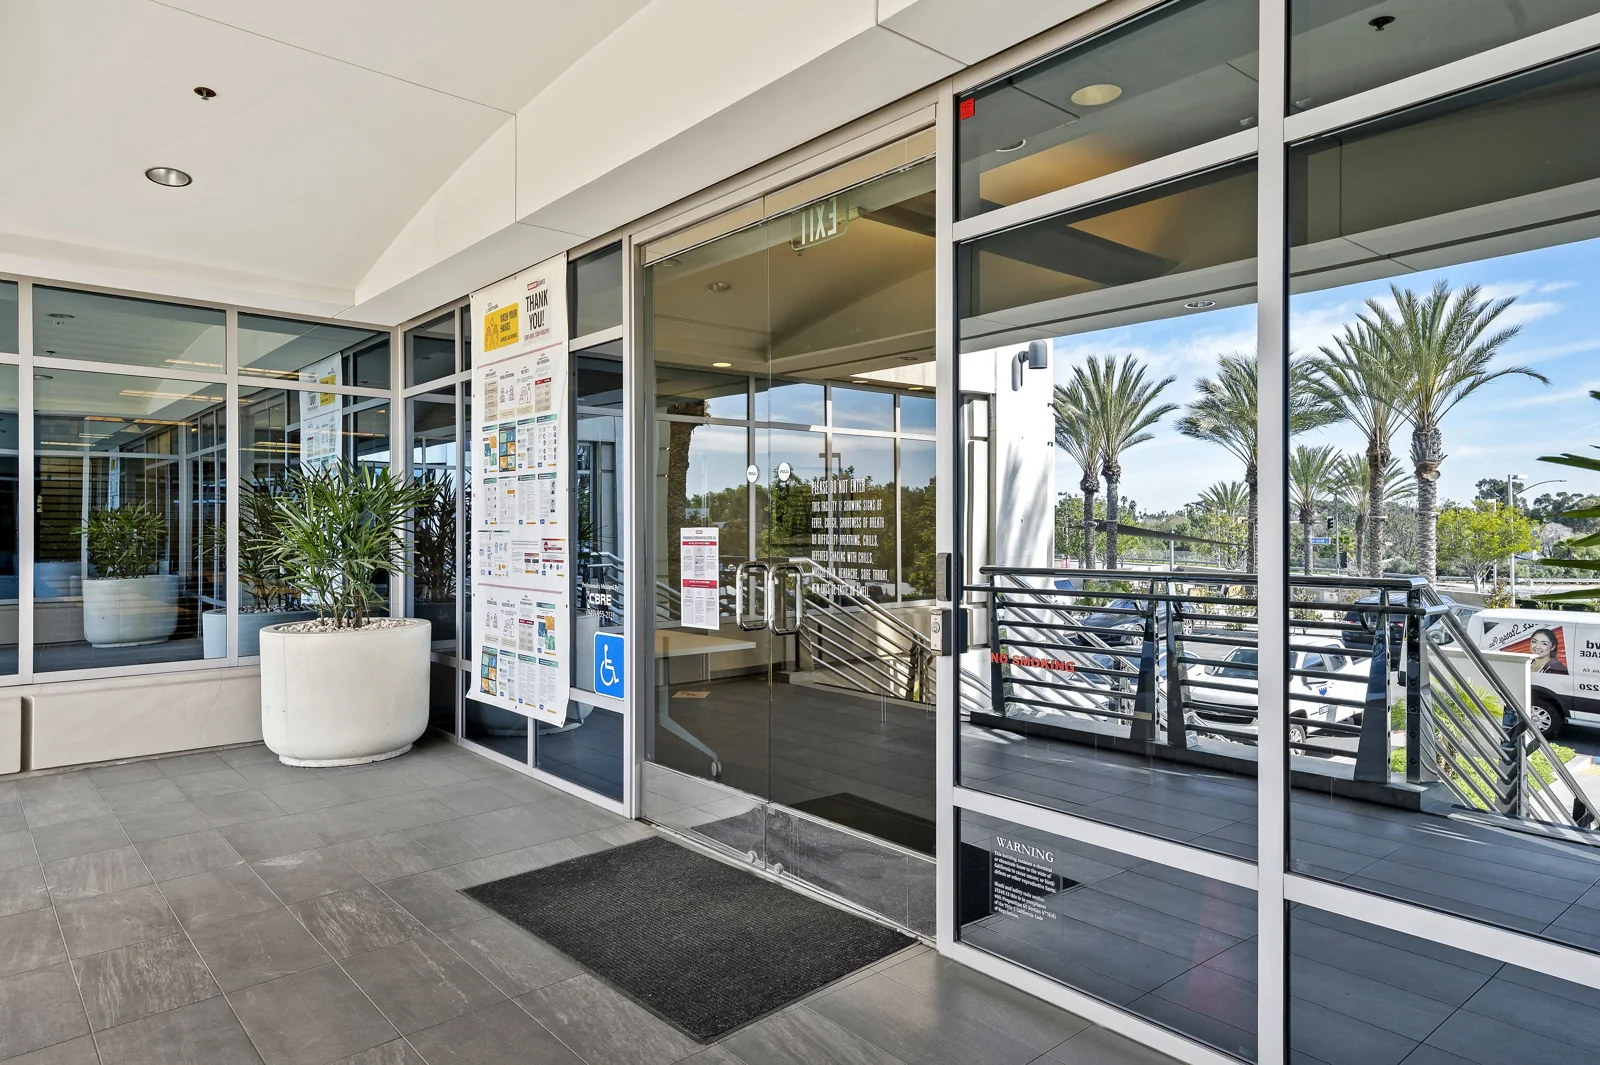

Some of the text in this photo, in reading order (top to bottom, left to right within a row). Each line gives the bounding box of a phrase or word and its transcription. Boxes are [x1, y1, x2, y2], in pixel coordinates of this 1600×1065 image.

[526, 289, 548, 312] THANK
[529, 310, 545, 330] YOU!
[811, 479, 865, 494] PLEASE DO NOT ENTER
[811, 502, 820, 512] THIS
[821, 501, 837, 511] FACILITY
[844, 500, 862, 511] SHOWING
[863, 499, 875, 510] SIGNS
[877, 499, 882, 510] OF
[839, 517, 861, 528] SHORTNESS
[863, 517, 868, 528] OF
[870, 517, 884, 528] BREATH
[812, 534, 816, 544] OR
[818, 534, 838, 545] DIFFICULTY
[863, 535, 878, 547] CHILLS,
[812, 551, 874, 564] REPEATED SHAKING WITH CHILLS,
[861, 569, 871, 580] SORE
[589, 593, 612, 606] CBRE
[991, 652, 1075, 672] NO SMOKING
[996, 836, 1054, 863] WARNING
[994, 863, 1011, 872] California
